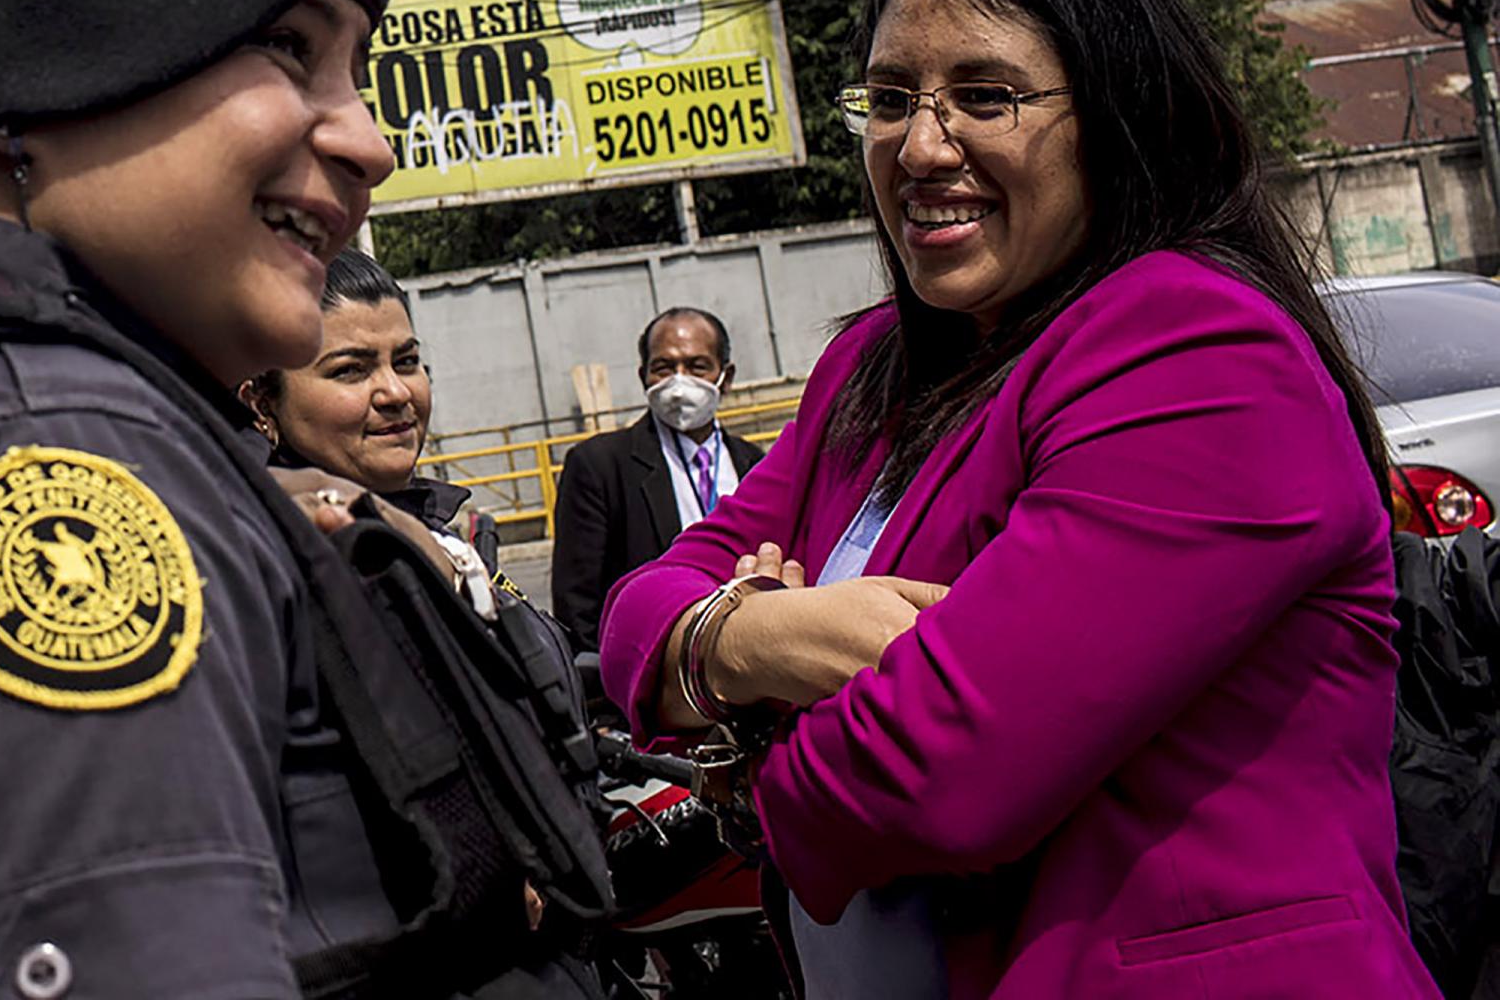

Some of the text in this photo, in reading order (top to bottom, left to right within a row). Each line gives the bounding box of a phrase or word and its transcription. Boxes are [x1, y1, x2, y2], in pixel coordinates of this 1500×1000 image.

[381, 8, 465, 47] COSA
[365, 38, 554, 130] OLOR
[586, 61, 764, 106] DISPONIBLE
[594, 98, 770, 163] 5201-0915
[16, 612, 152, 661] GUATEMALA
